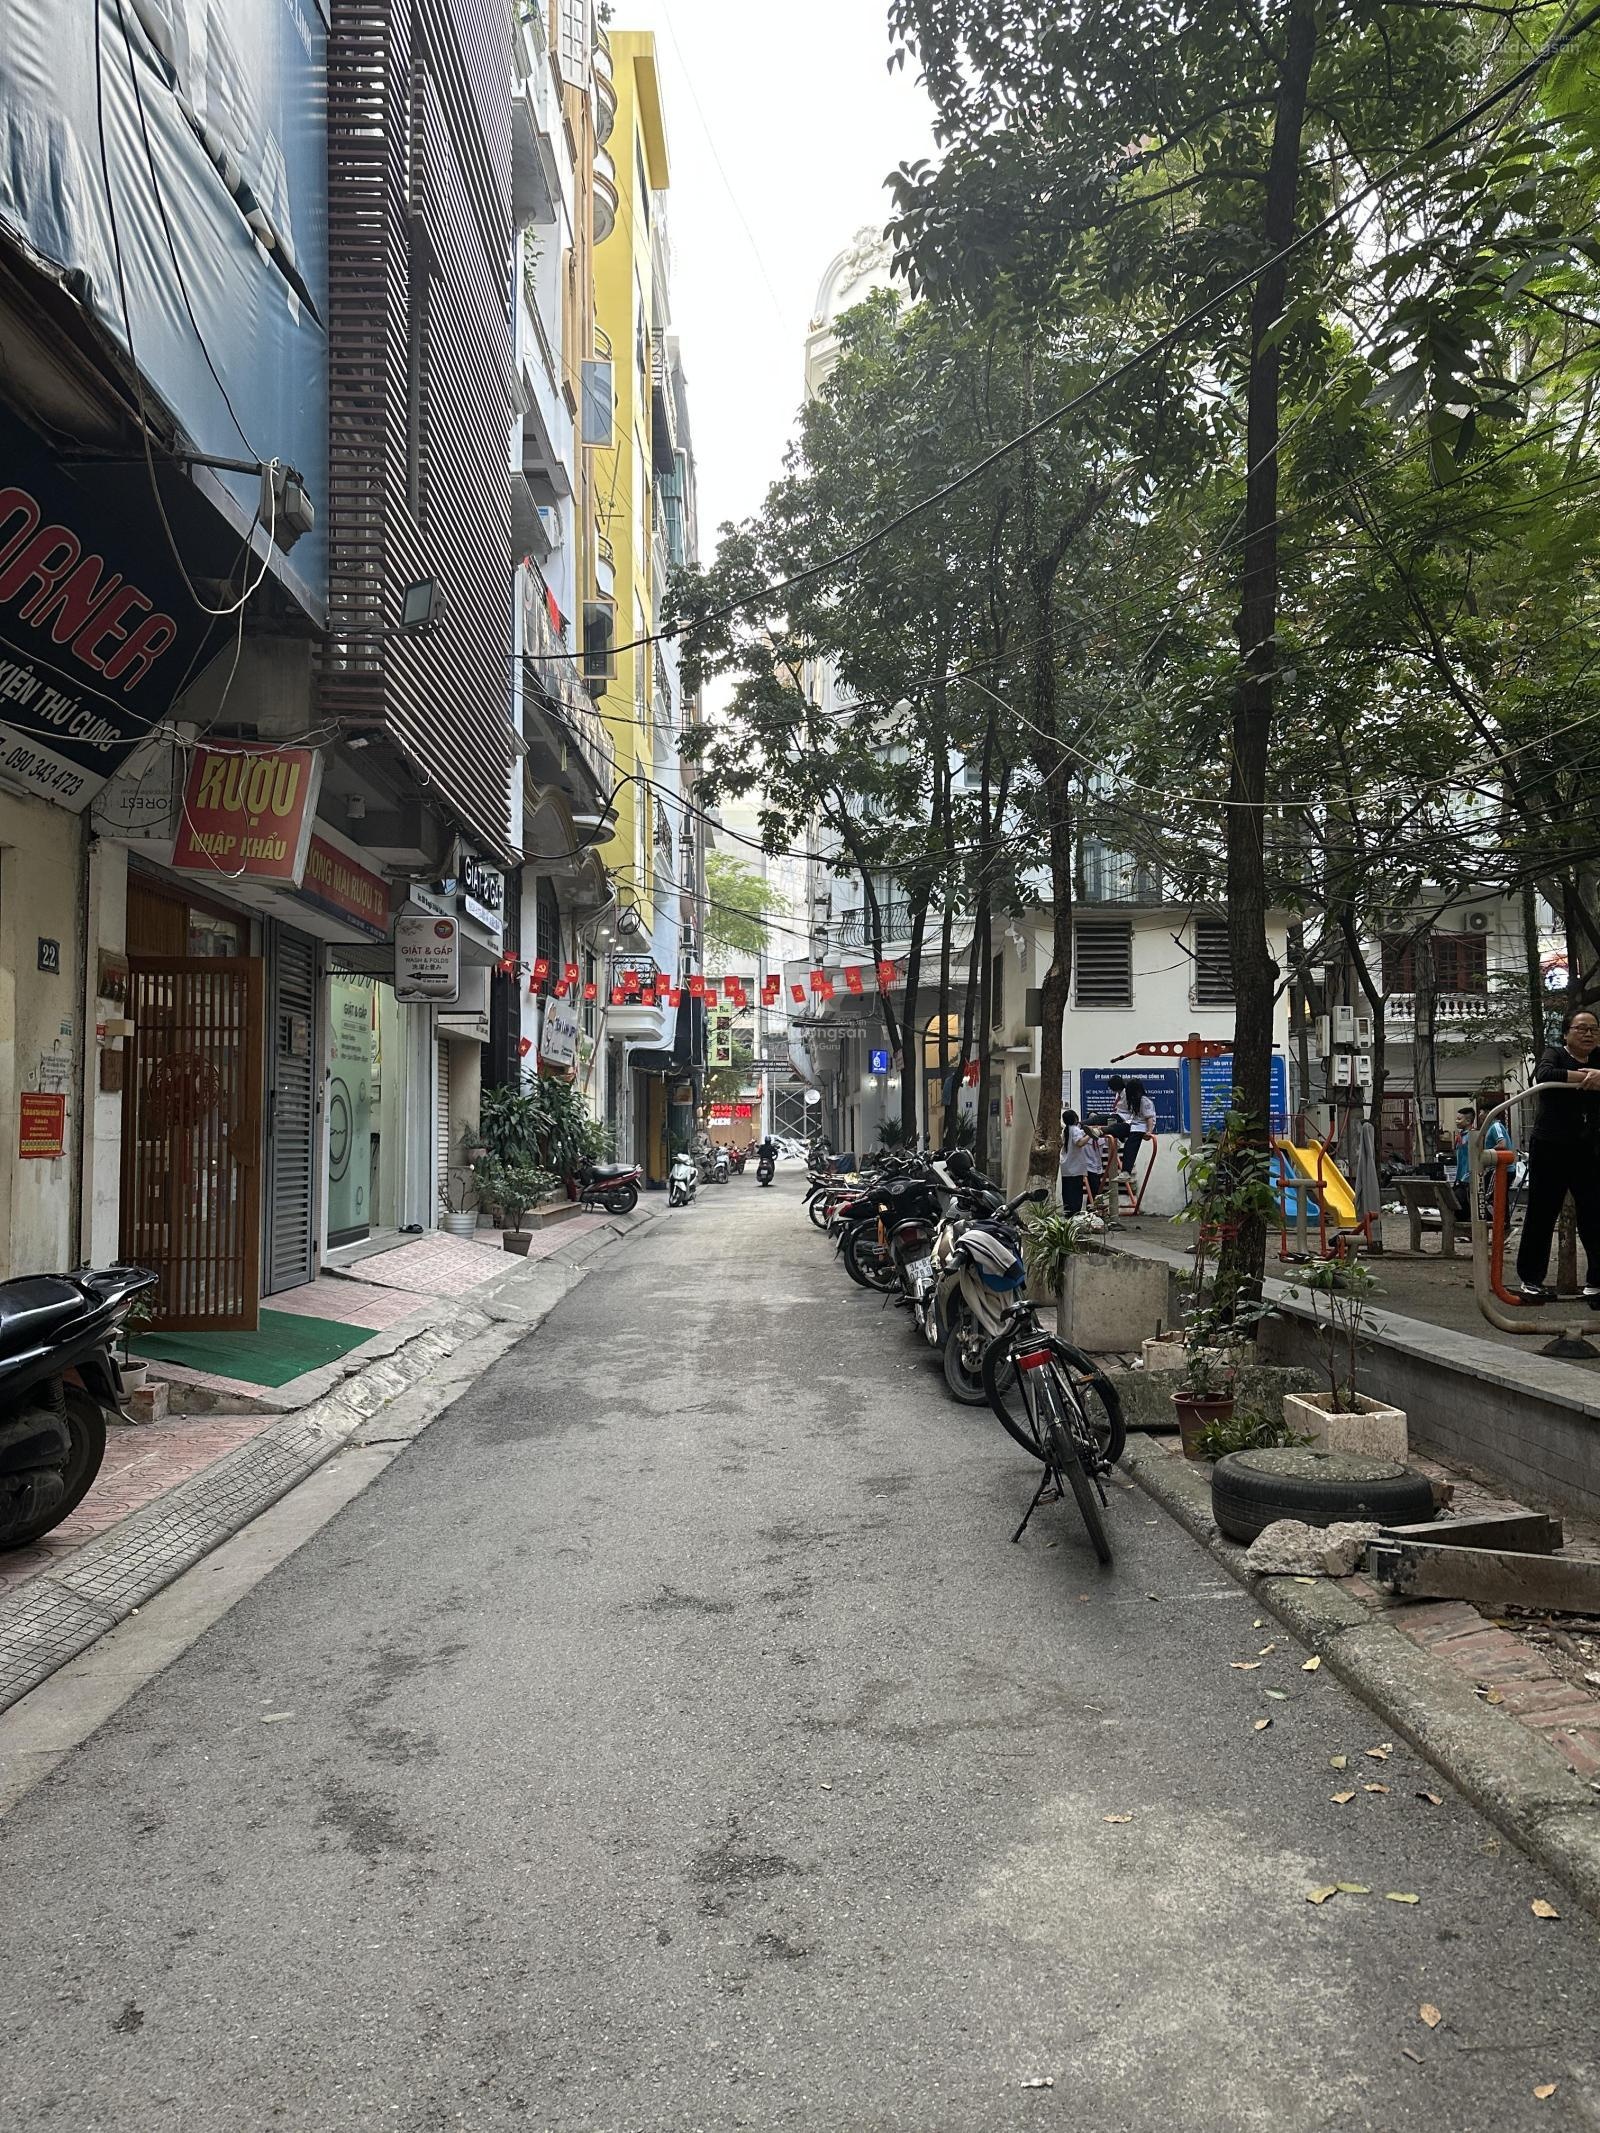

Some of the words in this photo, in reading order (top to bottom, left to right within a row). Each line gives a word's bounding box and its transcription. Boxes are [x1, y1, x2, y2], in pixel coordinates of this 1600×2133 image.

[32, 686, 82, 726] THÚ
[5, 746, 34, 773] 090
[28, 758, 58, 784] 343
[51, 769, 85, 796] 4723
[196, 755, 300, 827] RƯỢU
[188, 831, 237, 859] NHẬP
[240, 831, 288, 861] KHẨU
[42, 943, 57, 968] 22
[425, 946, 432, 956] &
